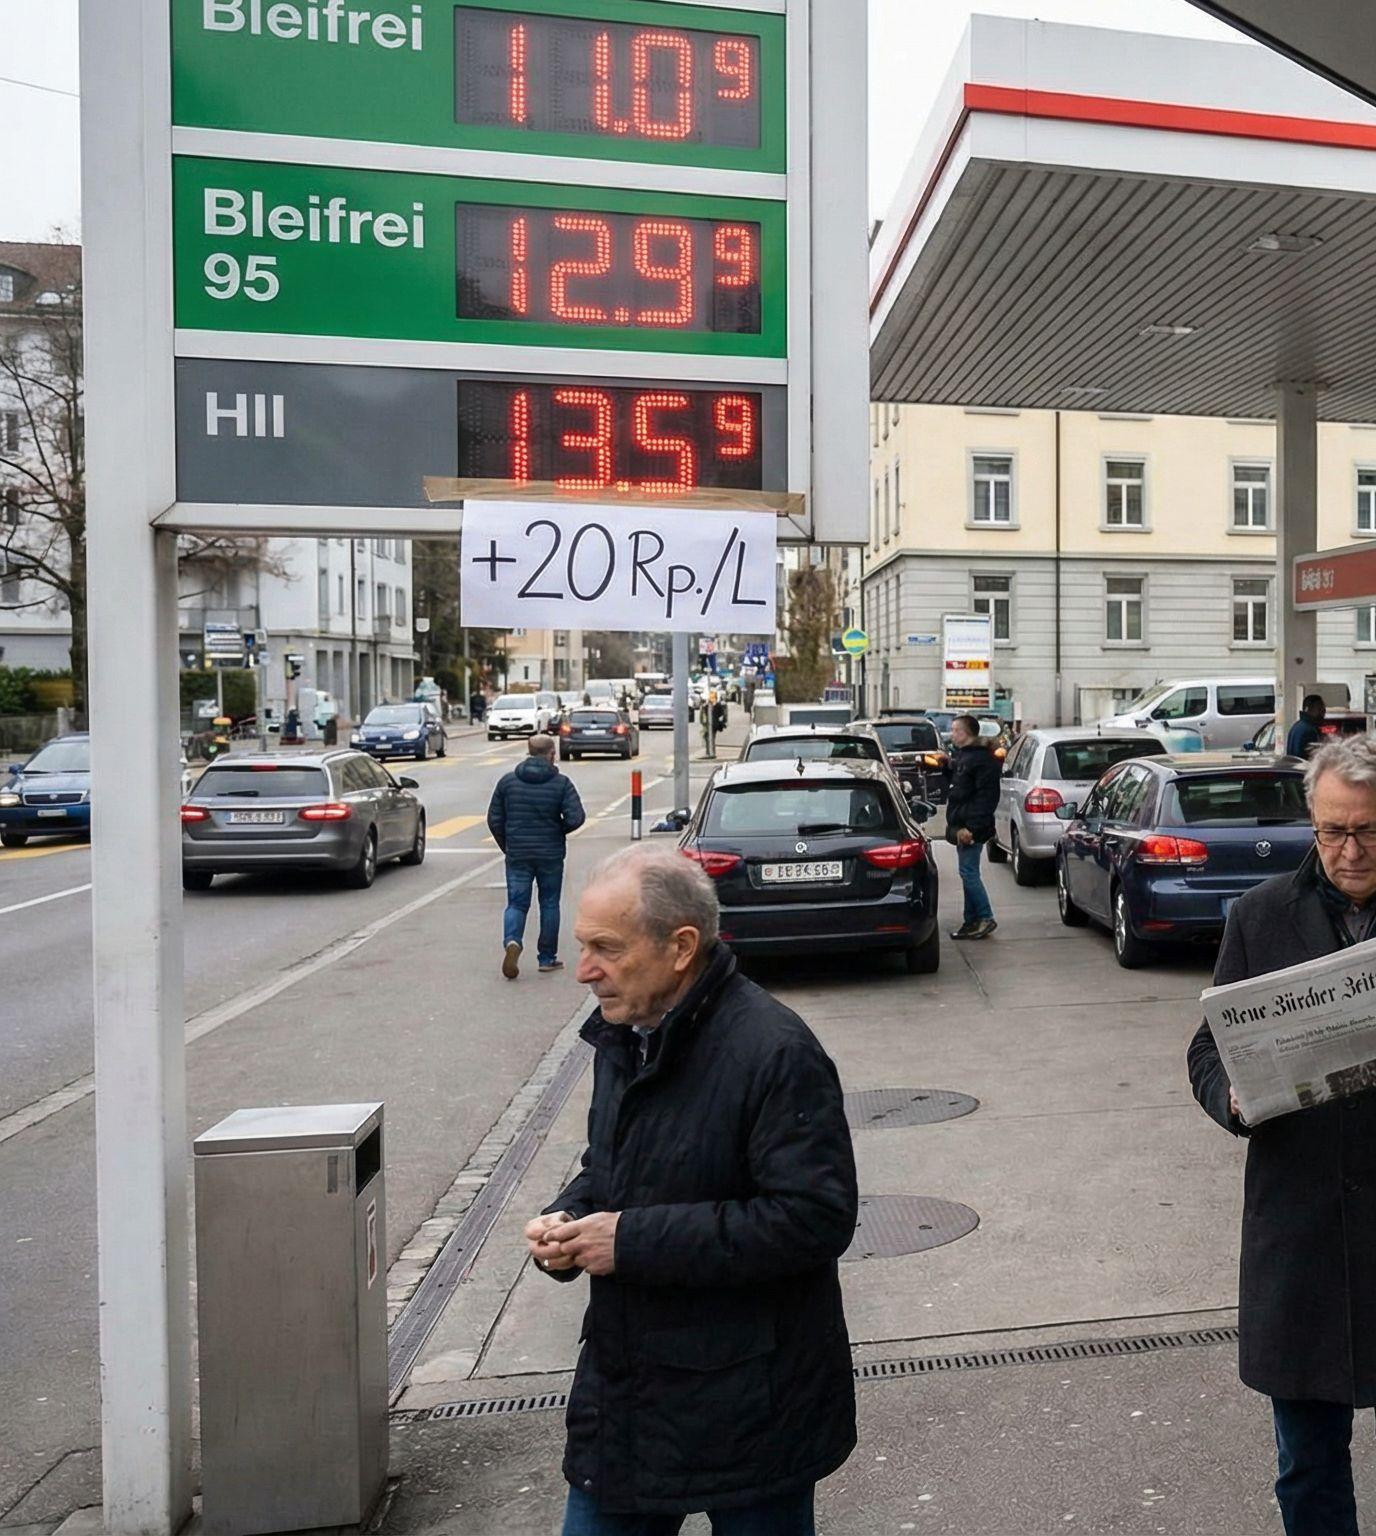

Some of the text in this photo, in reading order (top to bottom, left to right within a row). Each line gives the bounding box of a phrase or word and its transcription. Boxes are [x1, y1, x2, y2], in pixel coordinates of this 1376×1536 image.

[203, 0, 423, 50] Bleifrei
[203, 187, 424, 248] Bleifrei
[203, 252, 280, 302] 95
[471, 519, 767, 619] +20 Rp./L
[1222, 1004, 1267, 1028] Neue
[1272, 986, 1336, 1017] Zürcher
